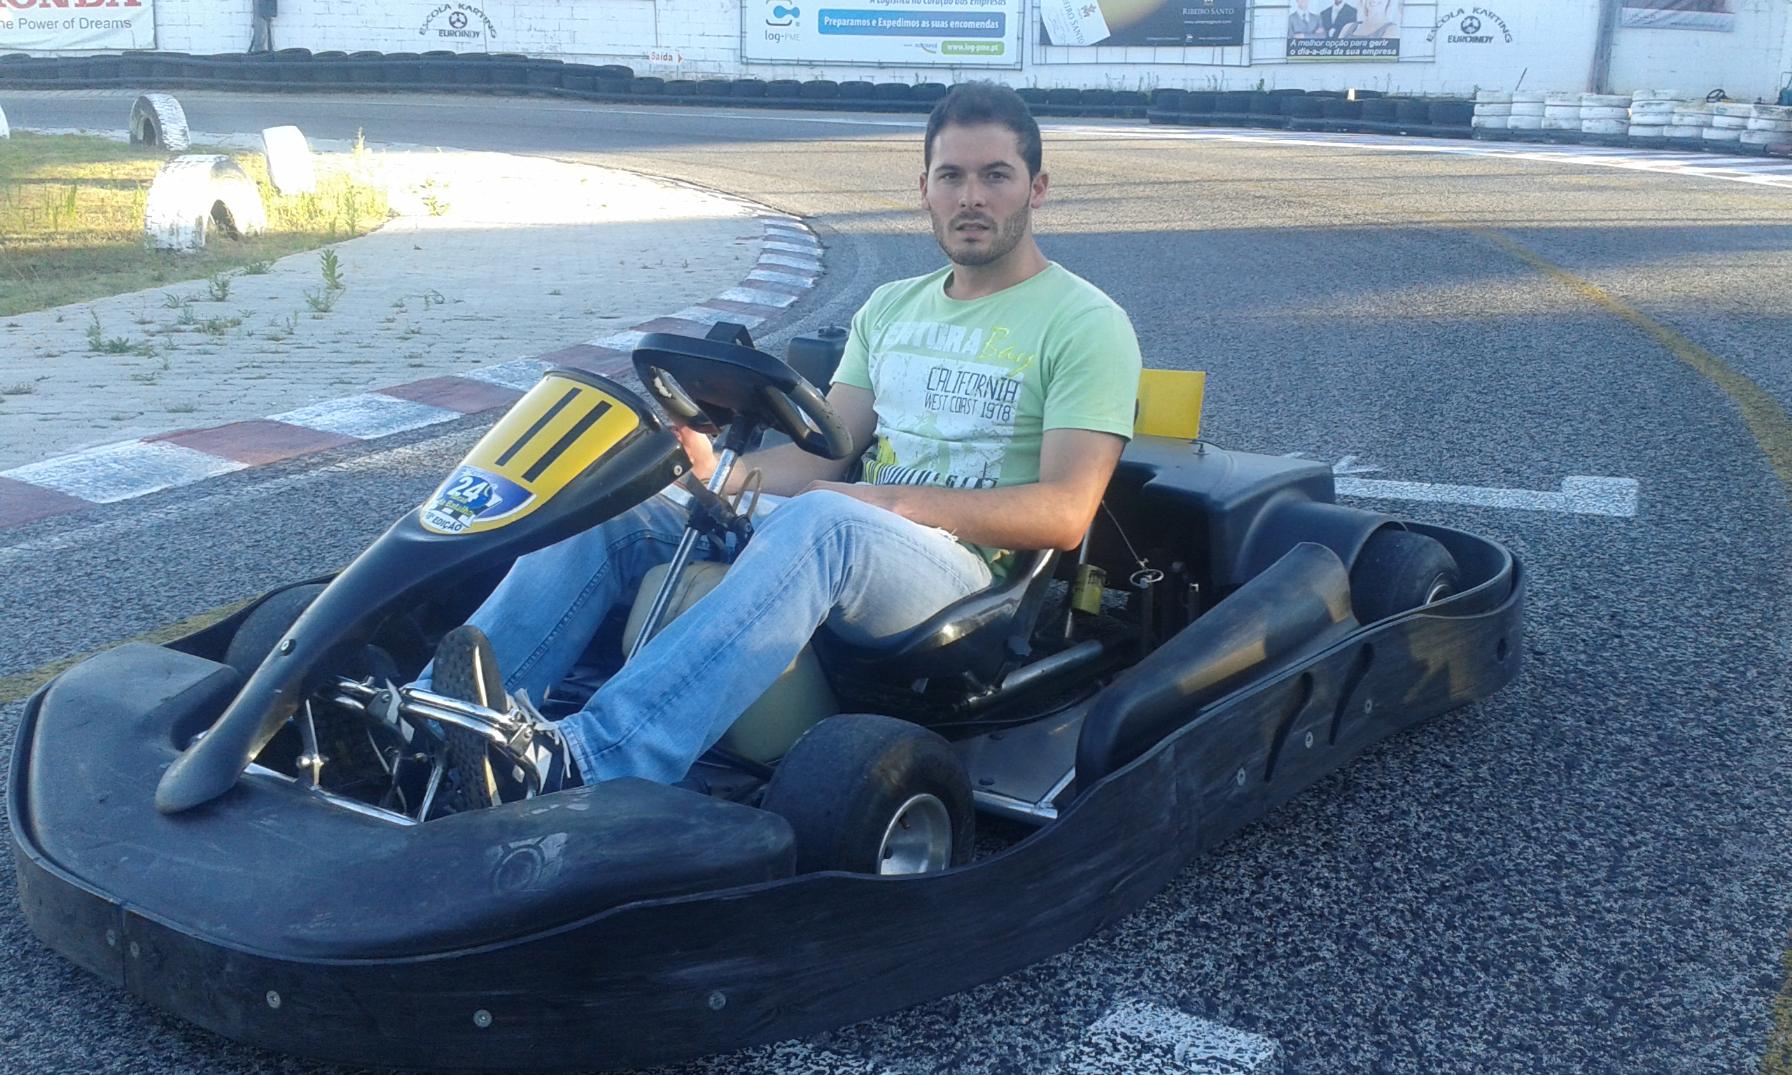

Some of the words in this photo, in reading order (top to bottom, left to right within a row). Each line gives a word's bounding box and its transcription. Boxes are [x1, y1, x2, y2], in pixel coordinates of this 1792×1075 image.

[18, 18, 60, 29] Power
[62, 18, 76, 29] of
[79, 18, 132, 29] Dreams
[419, 3, 452, 36] ESCOLA
[458, 3, 497, 39] KARTING
[824, 15, 871, 28] Preparamos
[871, 19, 878, 27] e
[878, 17, 919, 29] Expedimos
[920, 20, 930, 28] as
[931, 20, 949, 28] suas
[949, 19, 999, 29] encomendas
[1426, 8, 1465, 42] ESCOLA
[1472, 7, 1513, 44] KARTING
[438, 29, 480, 38] EUROINDY
[1447, 34, 1494, 44] EUROINDY
[1290, 39, 1297, 47] A
[1298, 39, 1324, 47] melhor
[1350, 40, 1368, 48] para
[1369, 39, 1389, 49] gerir
[1297, 47, 1332, 56] dia-a-dia
[1333, 47, 1344, 55] da
[1362, 49, 1397, 57] empresa
[926, 366, 1021, 403] CALIFORNIA
[924, 391, 949, 411] WEST
[949, 395, 979, 416] COAST
[980, 400, 1012, 423] 1978
[446, 476, 489, 503] 24
